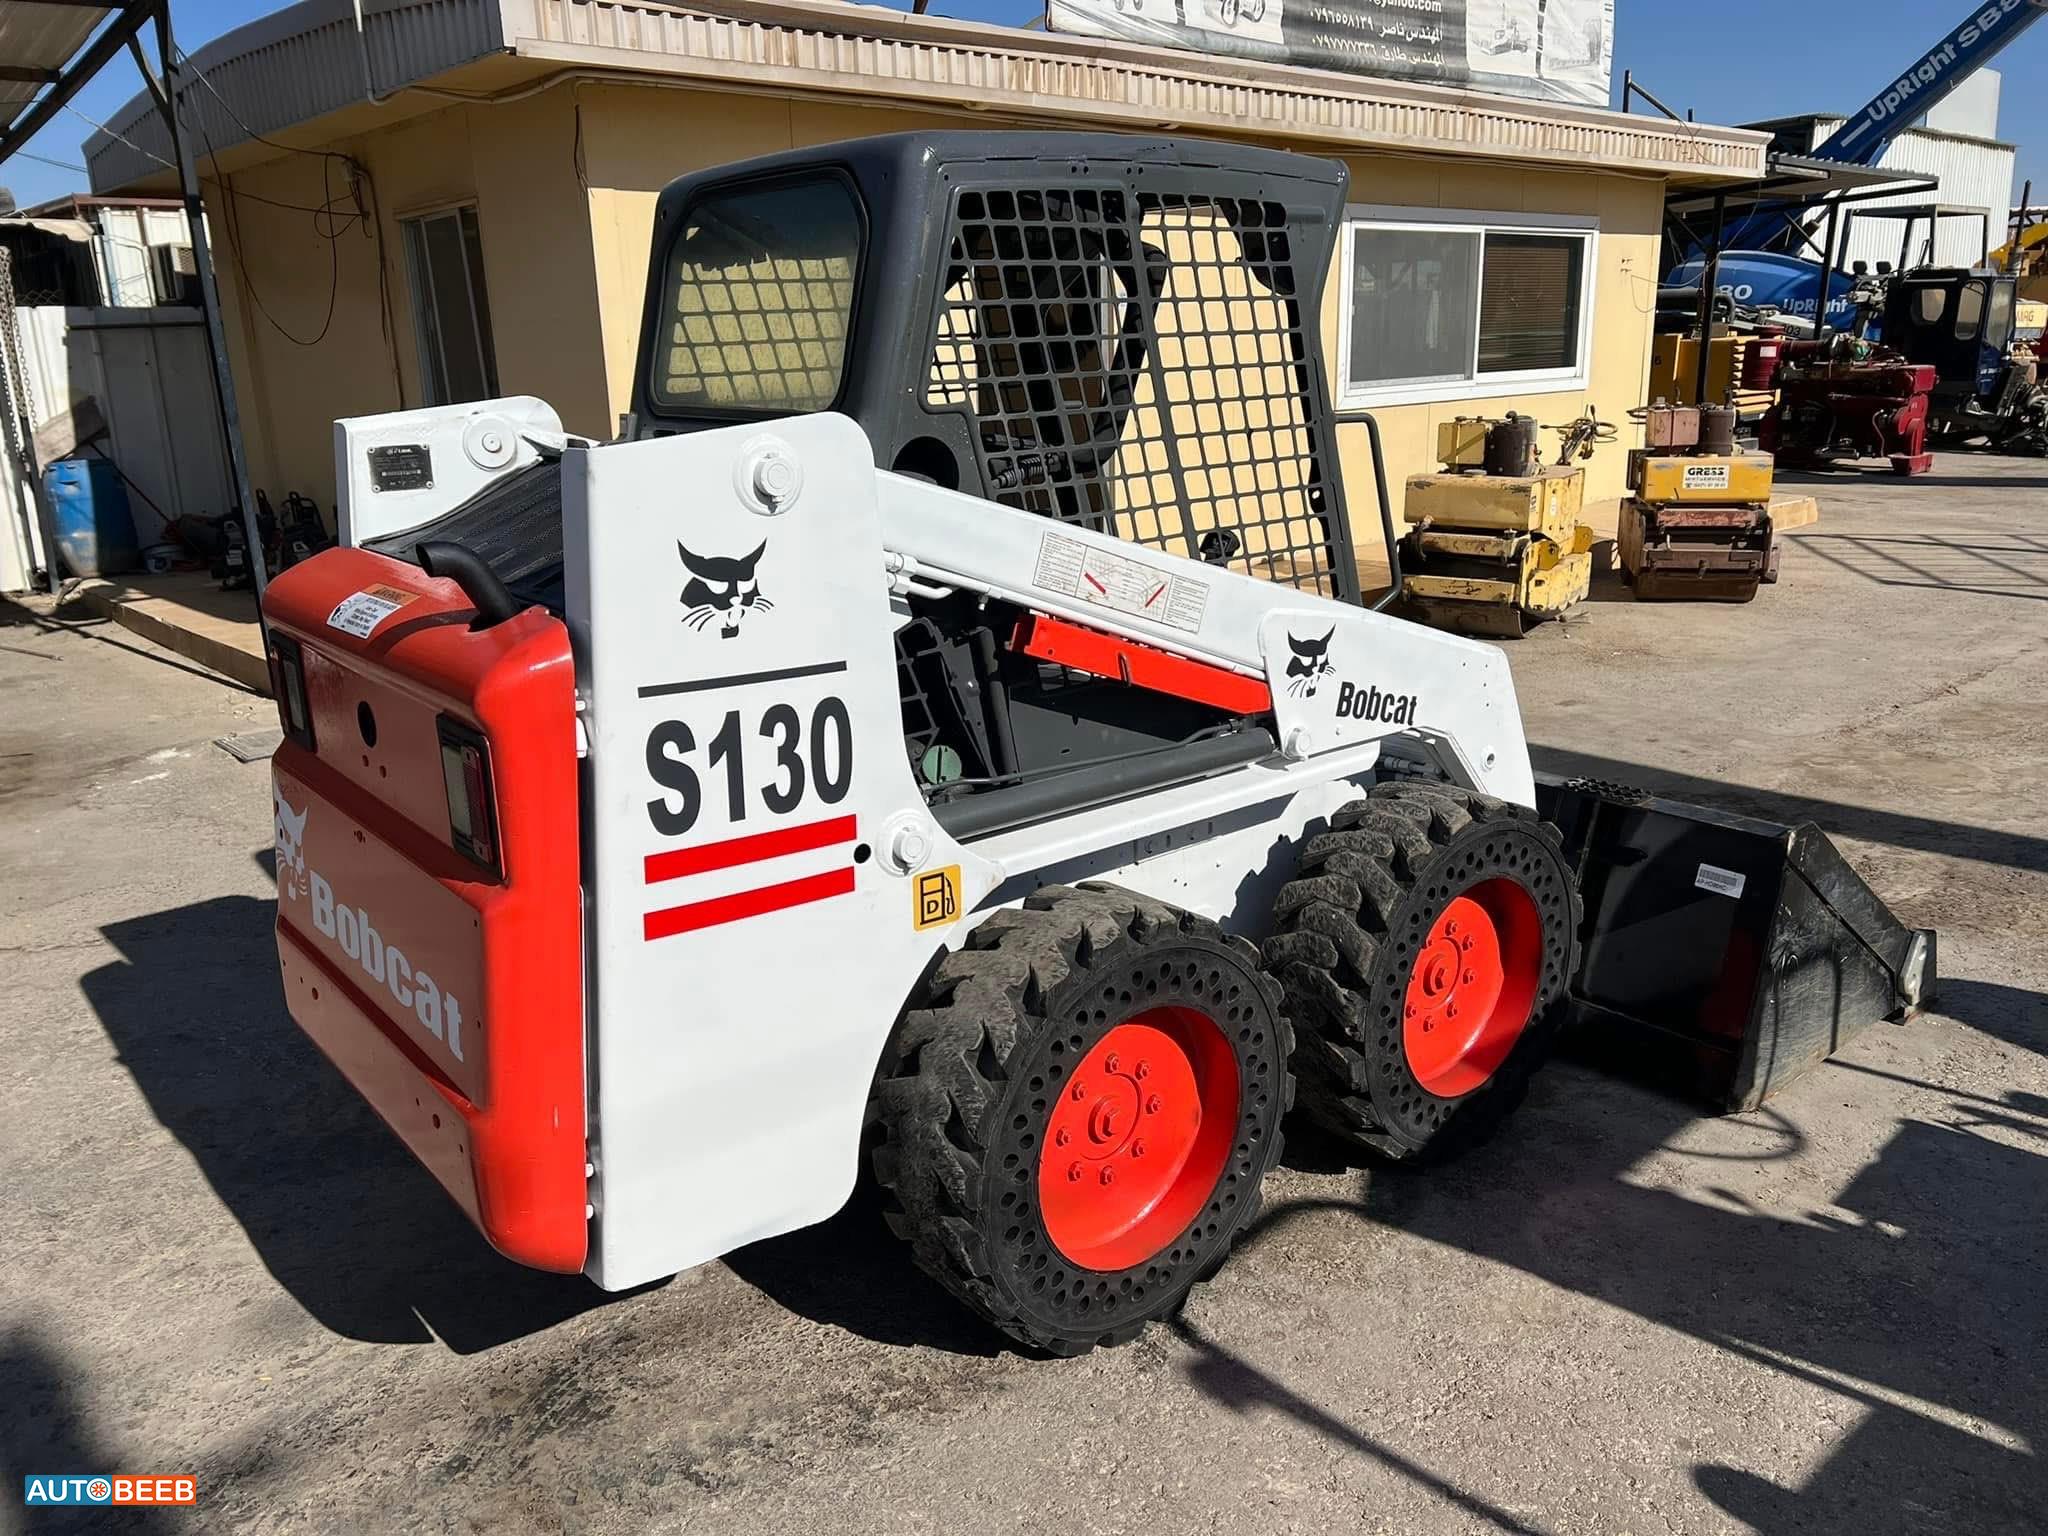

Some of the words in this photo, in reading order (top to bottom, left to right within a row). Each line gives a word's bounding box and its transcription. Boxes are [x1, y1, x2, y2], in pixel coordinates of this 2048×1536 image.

[1867, 42, 1957, 121] UpRight
[1688, 467, 1725, 476] GRESS
[1335, 681, 1418, 726] Bobcat
[646, 696, 854, 836] S130
[310, 869, 464, 1063] Bobcat
